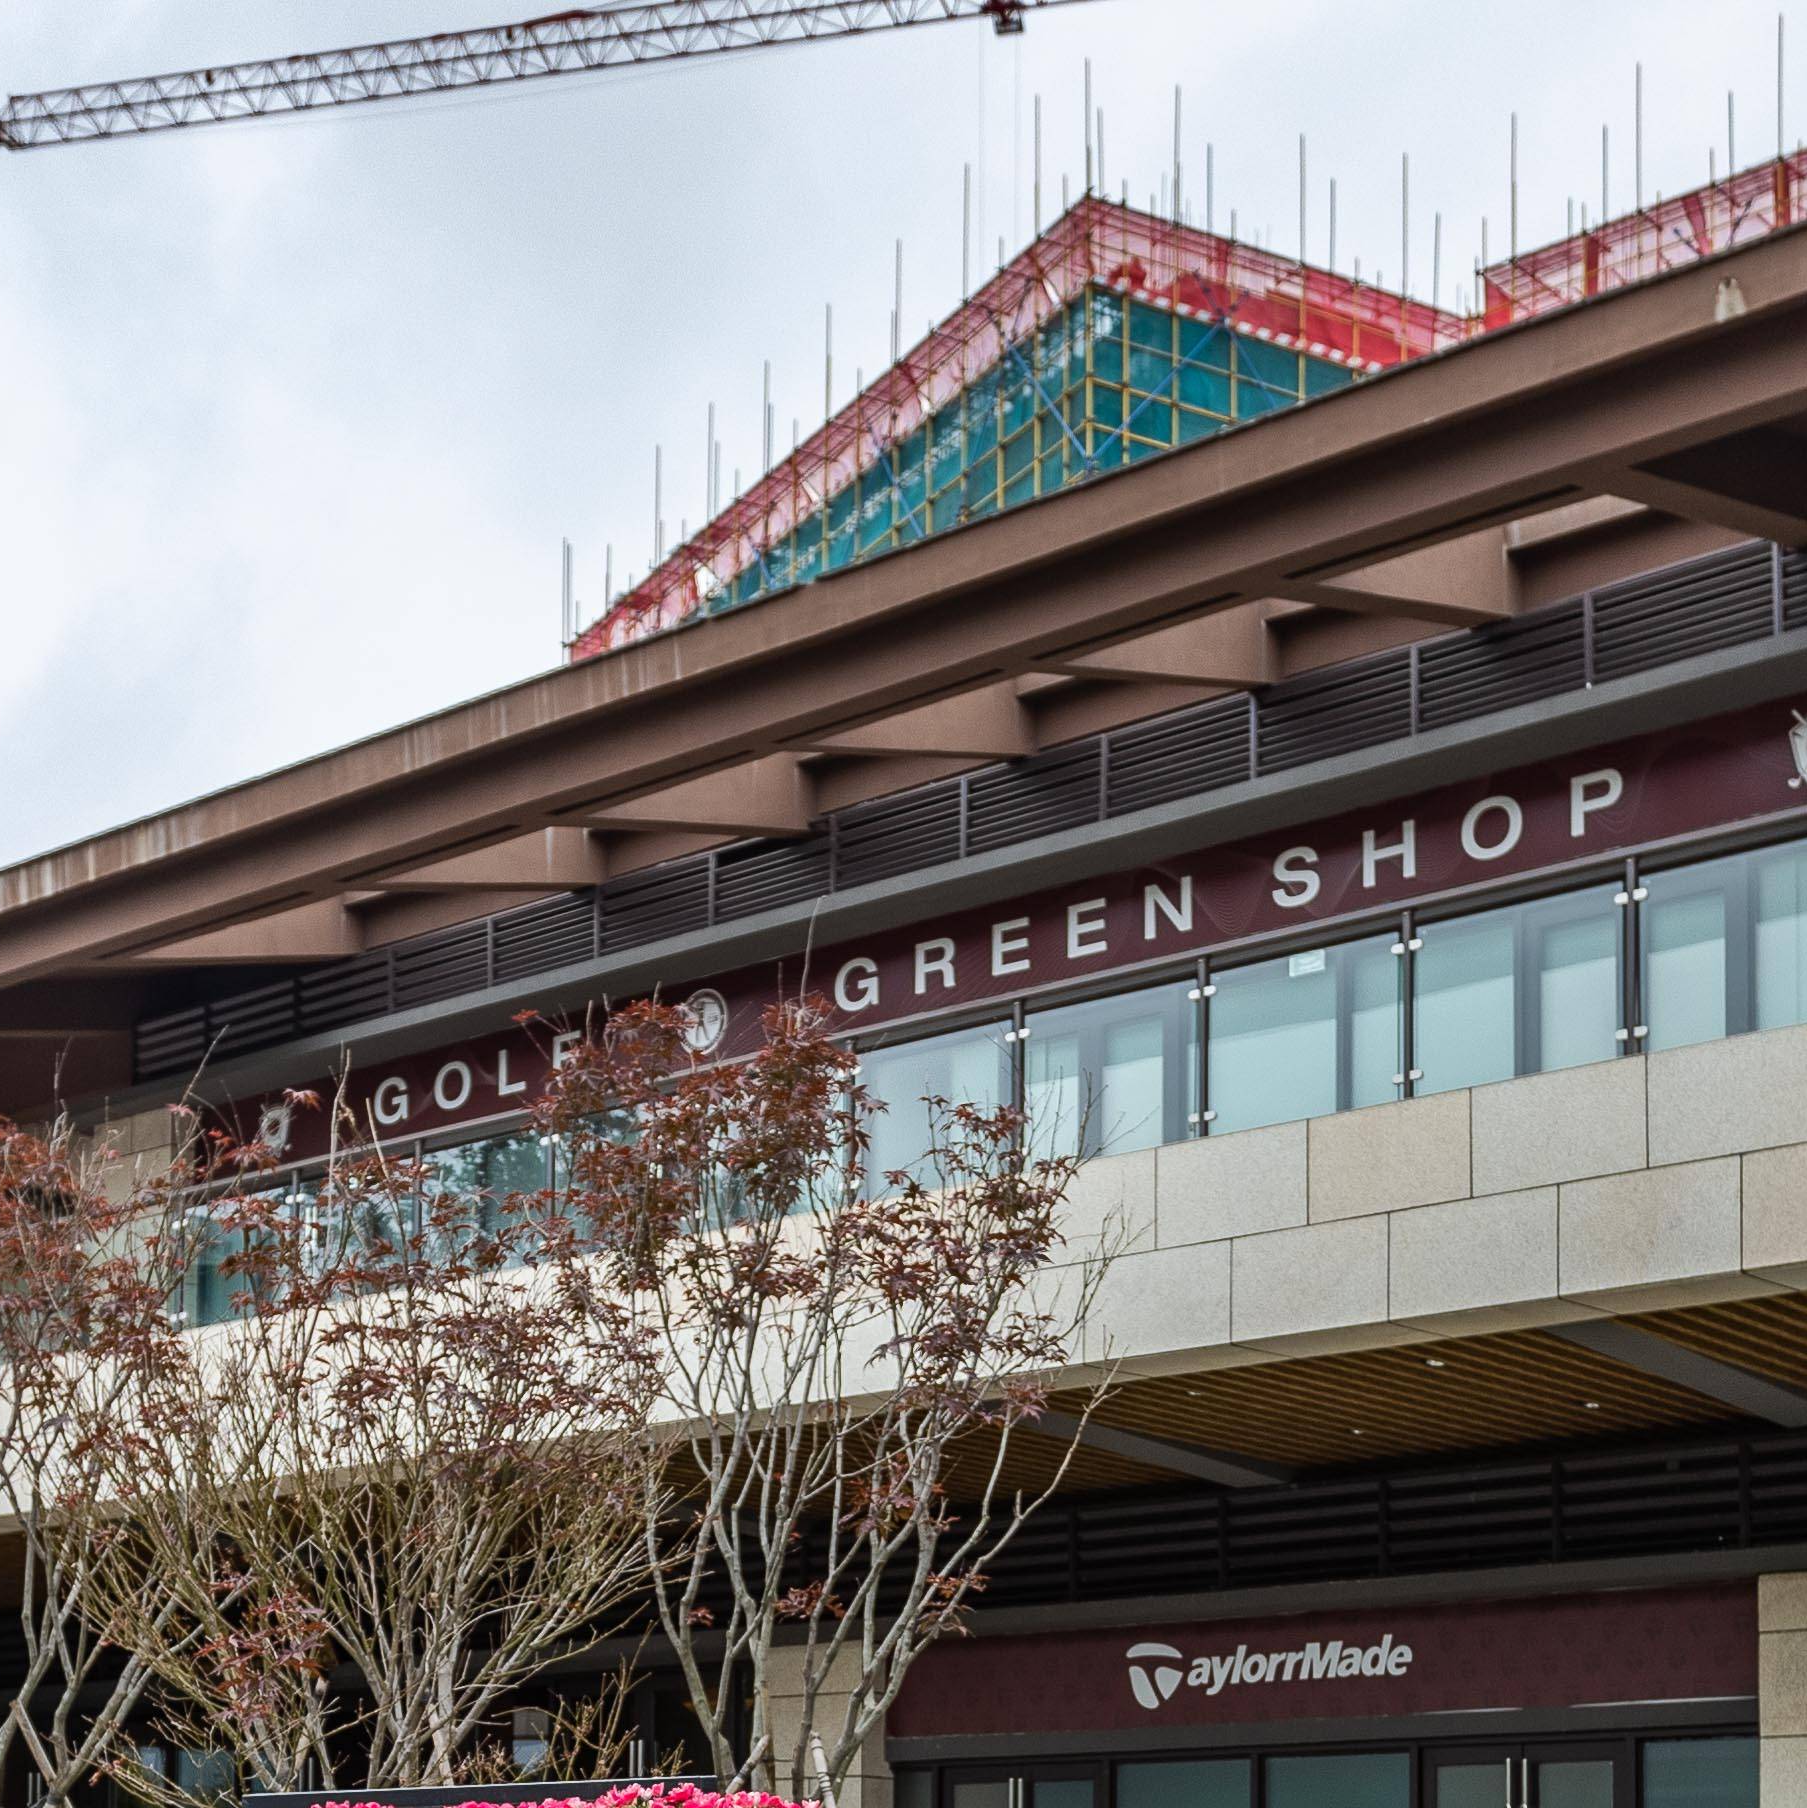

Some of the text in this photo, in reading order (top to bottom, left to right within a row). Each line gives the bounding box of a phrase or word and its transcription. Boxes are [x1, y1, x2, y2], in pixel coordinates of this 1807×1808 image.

[832, 767, 1626, 1013] GREEN SHOP
[373, 1029, 583, 1127] GOLF
